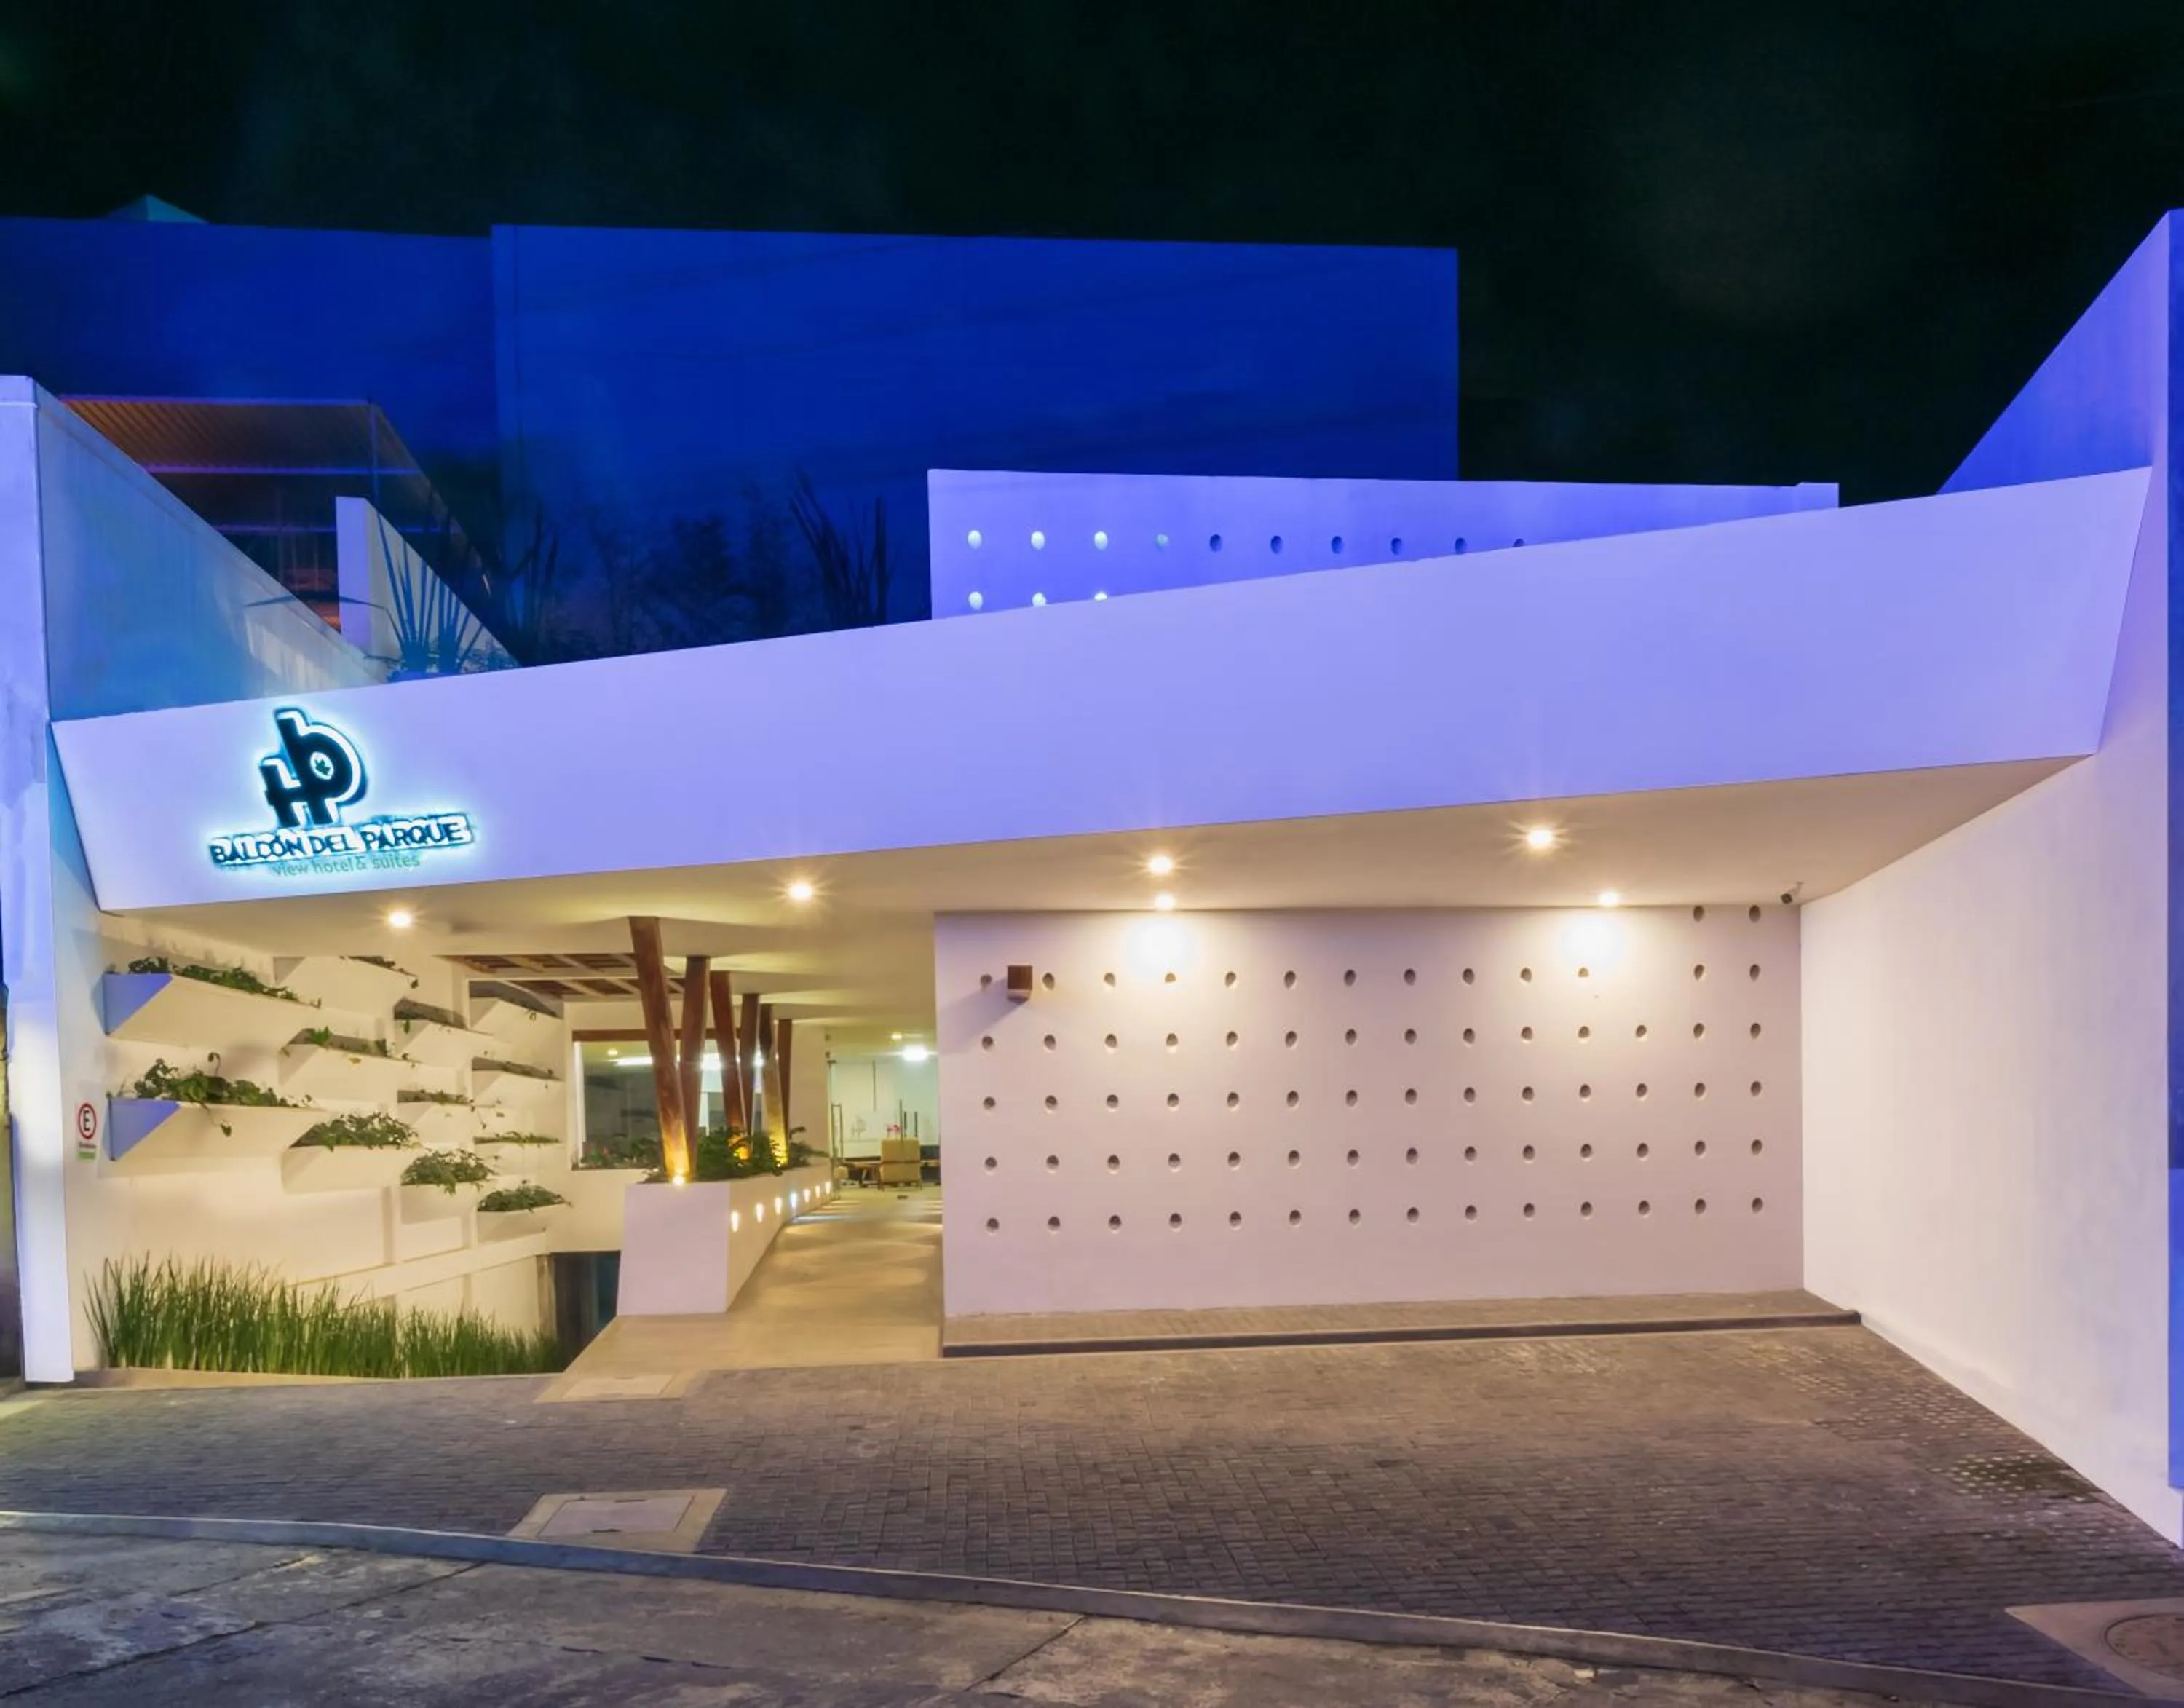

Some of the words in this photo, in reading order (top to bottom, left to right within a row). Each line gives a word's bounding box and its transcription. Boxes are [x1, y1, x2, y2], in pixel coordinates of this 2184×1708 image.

[309, 832, 360, 854] DEL
[360, 820, 466, 851] PARQUE
[312, 855, 353, 874] hotel
[355, 855, 366, 871] &
[372, 852, 421, 870] suites
[83, 1110, 91, 1131] E
